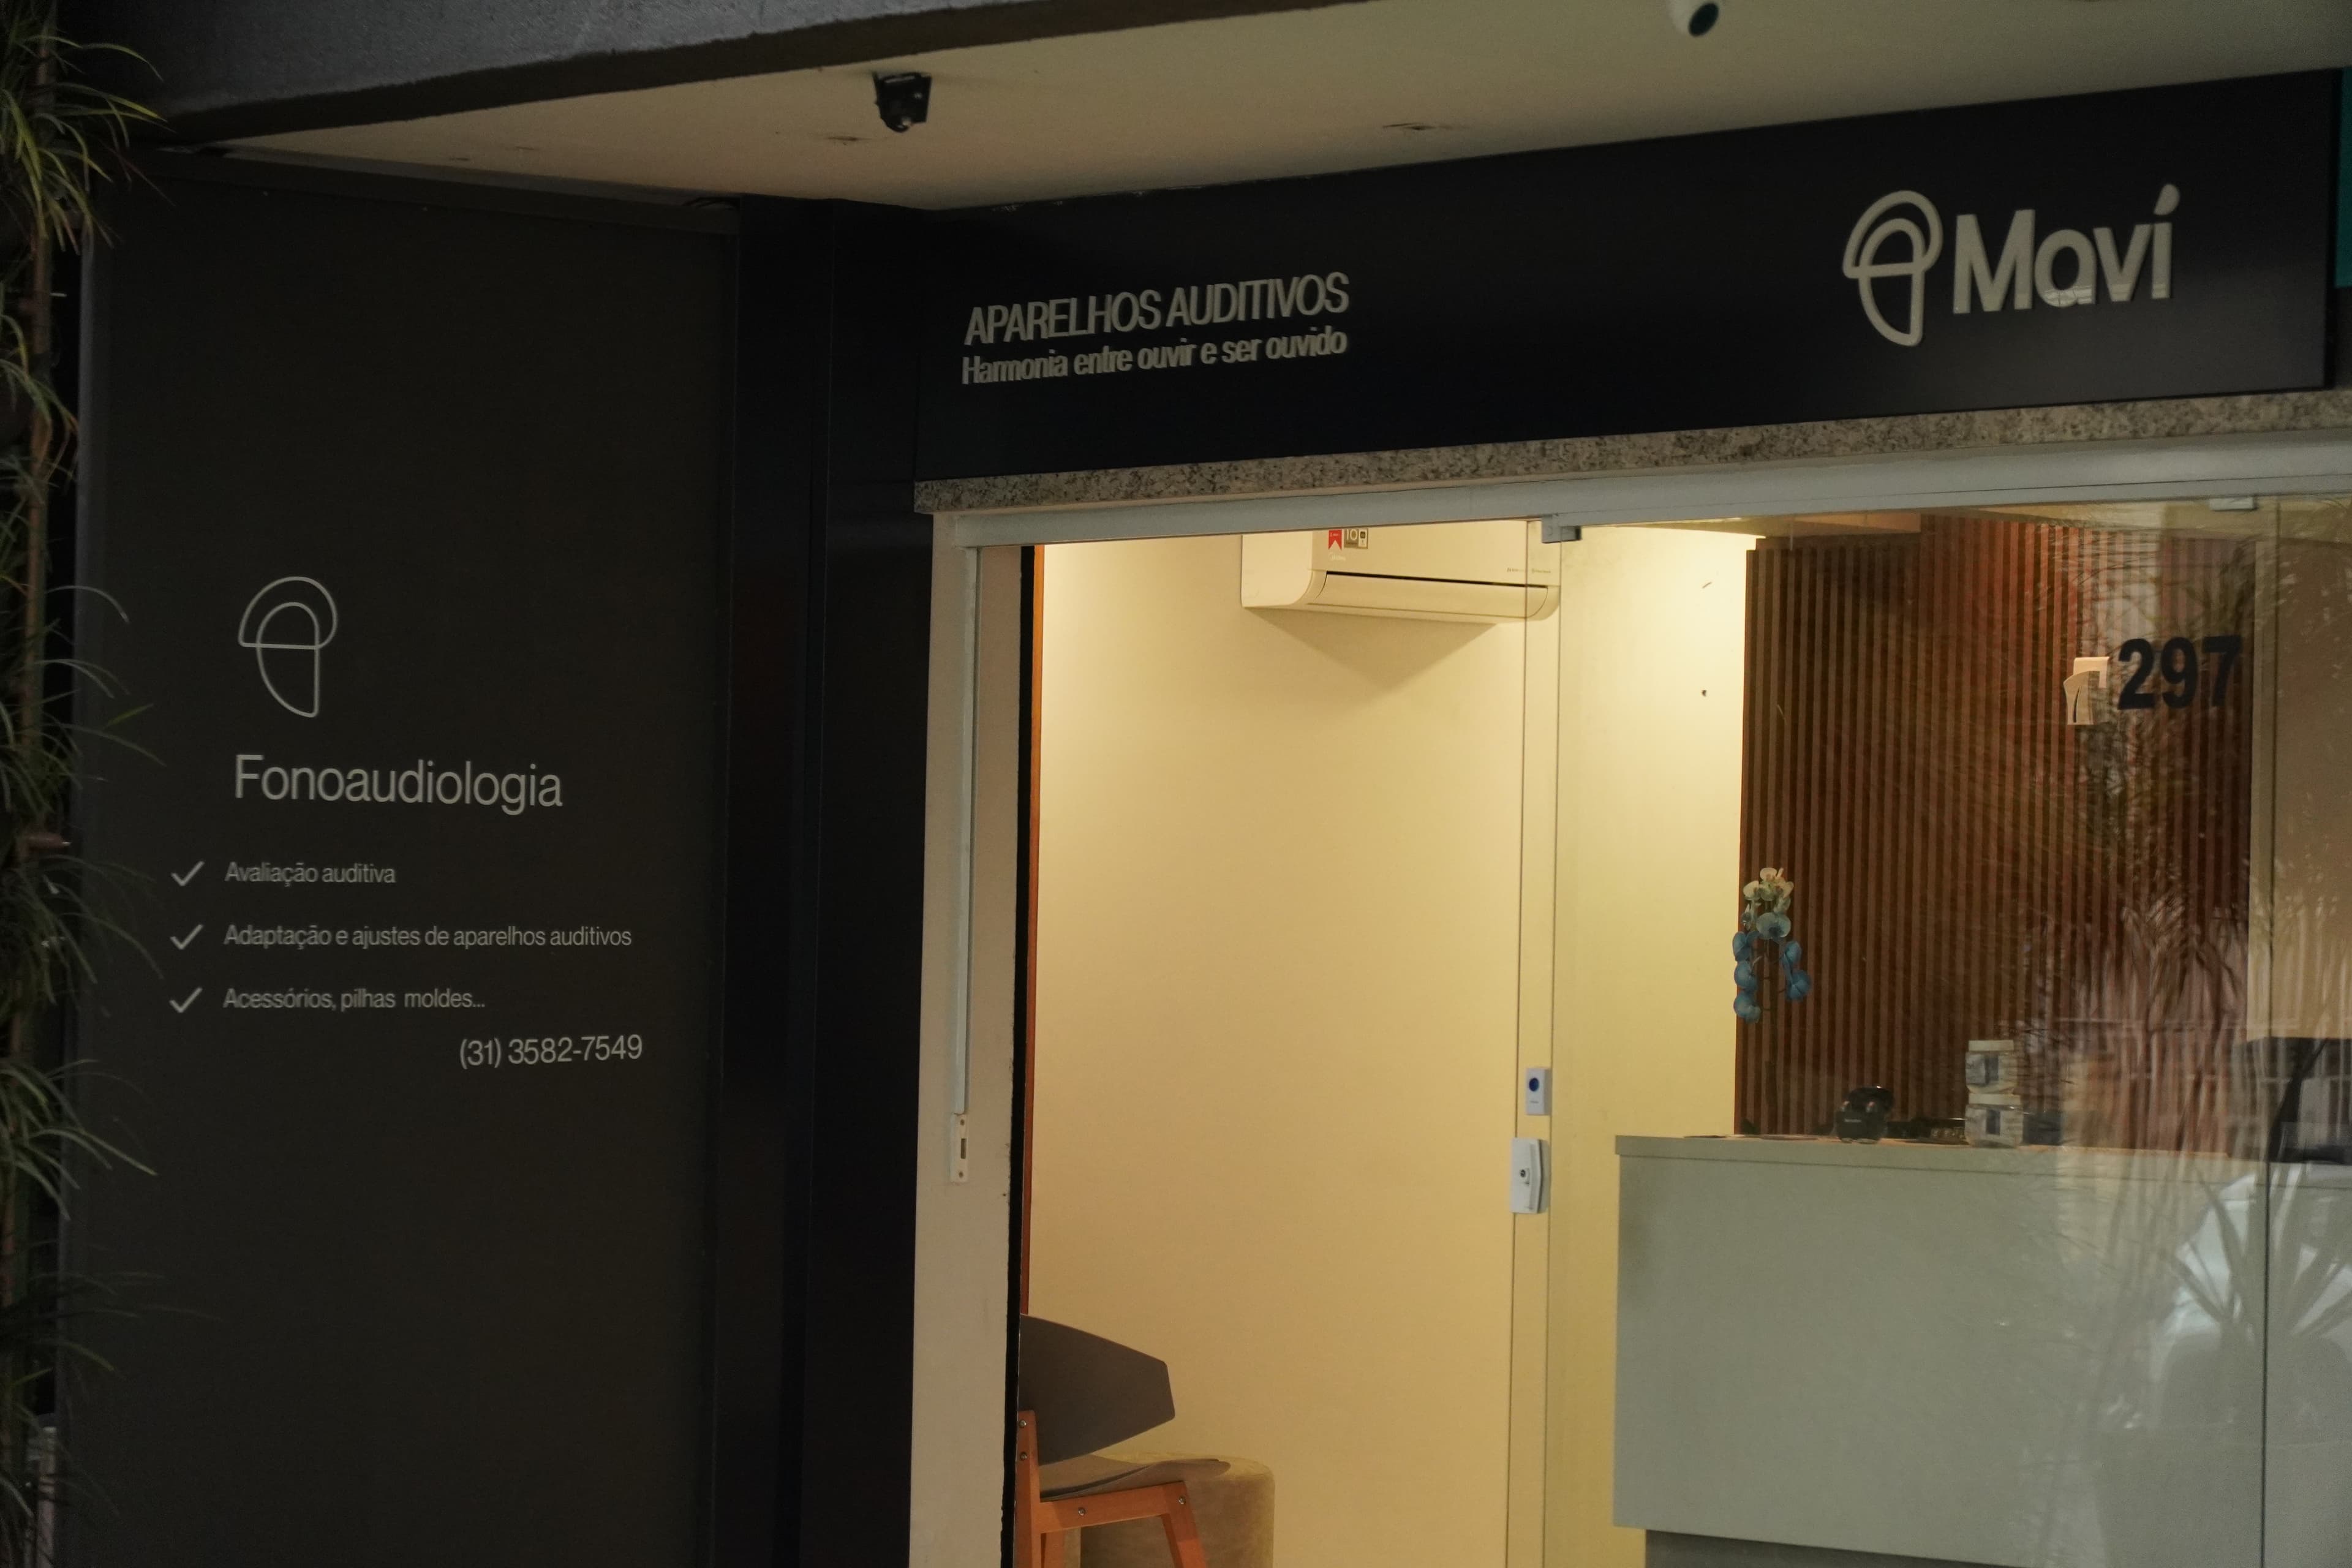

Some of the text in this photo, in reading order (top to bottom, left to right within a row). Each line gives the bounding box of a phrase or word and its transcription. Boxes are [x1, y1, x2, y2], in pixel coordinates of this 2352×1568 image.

[964, 272, 1349, 345] APARELHOS AUDITIVOS
[962, 325, 1348, 385] Harmonia entre ouvir e ser ouvido
[2118, 635, 2241, 710] 297
[235, 754, 563, 816] Fonoaudiologia
[224, 861, 396, 888] Avaliação auditiva
[224, 924, 632, 950] Adaptação e ajustes de aparelhos auditivos
[223, 987, 486, 1012] Acessórios, pilhas moldes...
[459, 1034, 643, 1069] (31) 3582-7549
